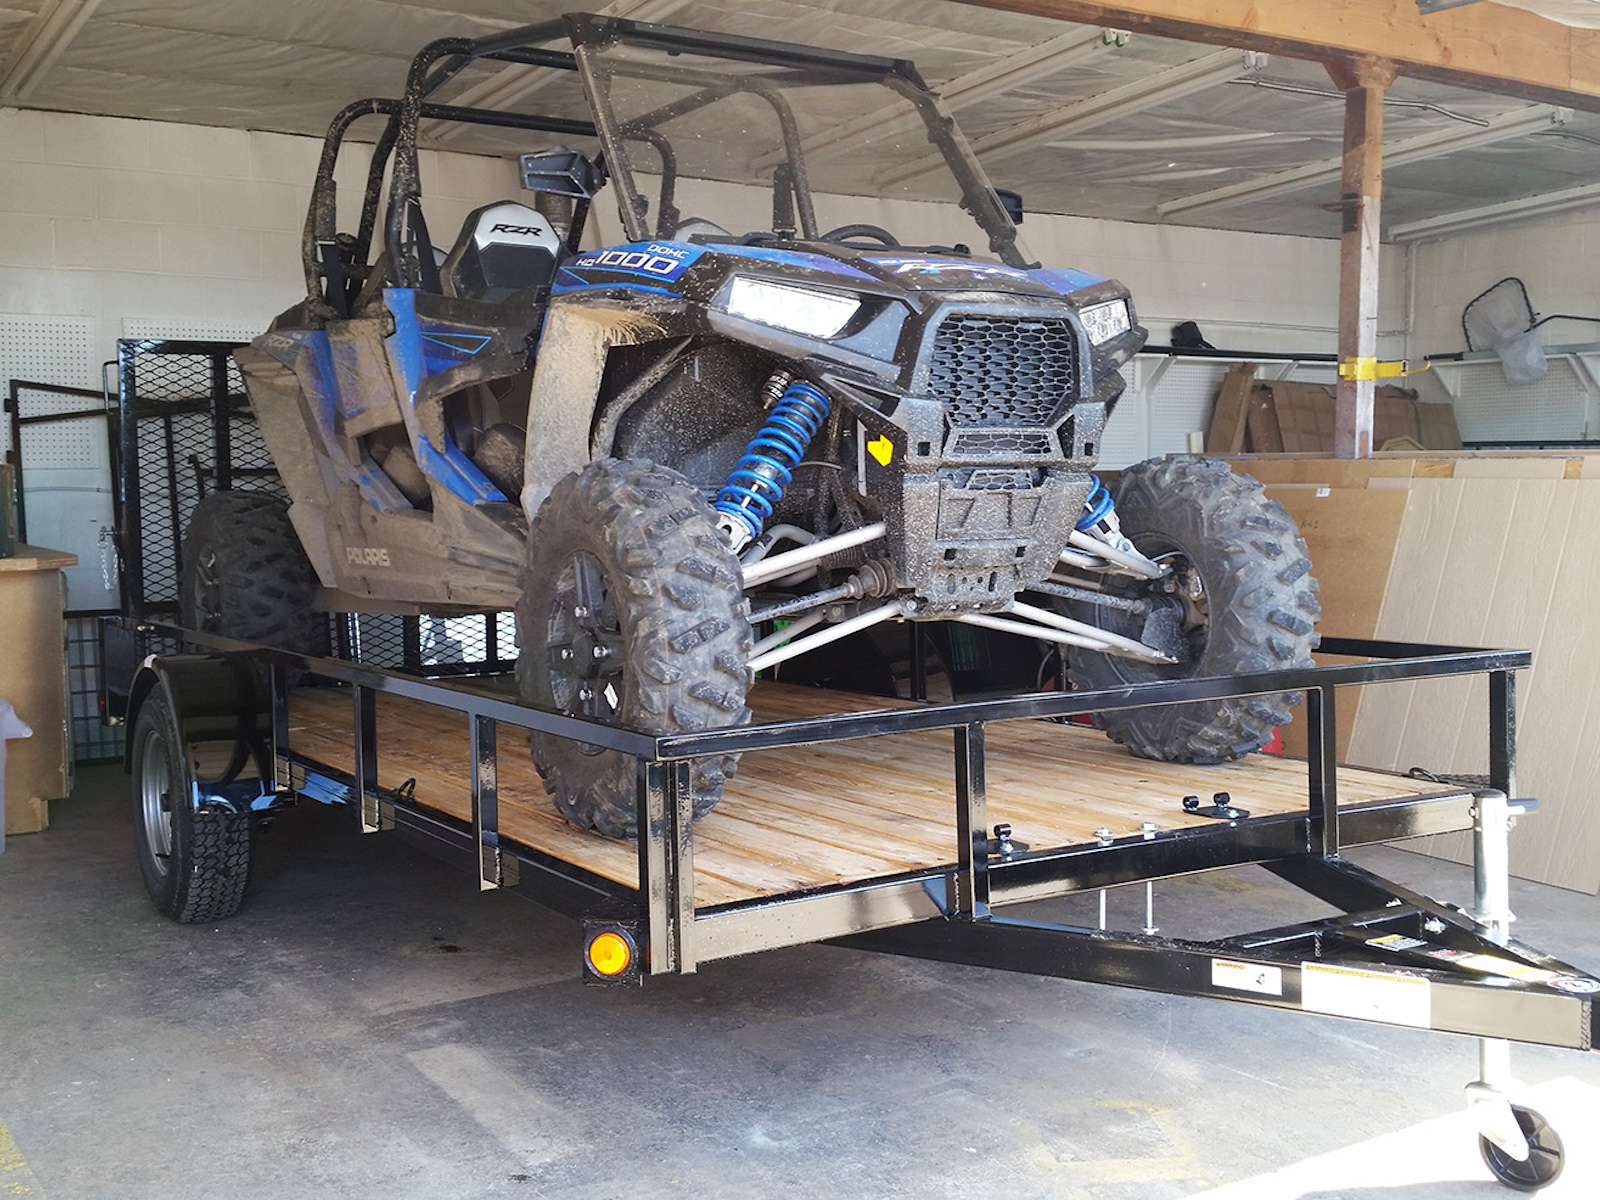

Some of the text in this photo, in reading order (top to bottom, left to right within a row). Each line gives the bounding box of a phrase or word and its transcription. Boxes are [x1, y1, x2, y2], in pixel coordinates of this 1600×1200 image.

[490, 223, 542, 237] RZR
[647, 243, 690, 259] DOHC
[596, 250, 680, 275] 1000
[345, 546, 391, 567] POLARIS
